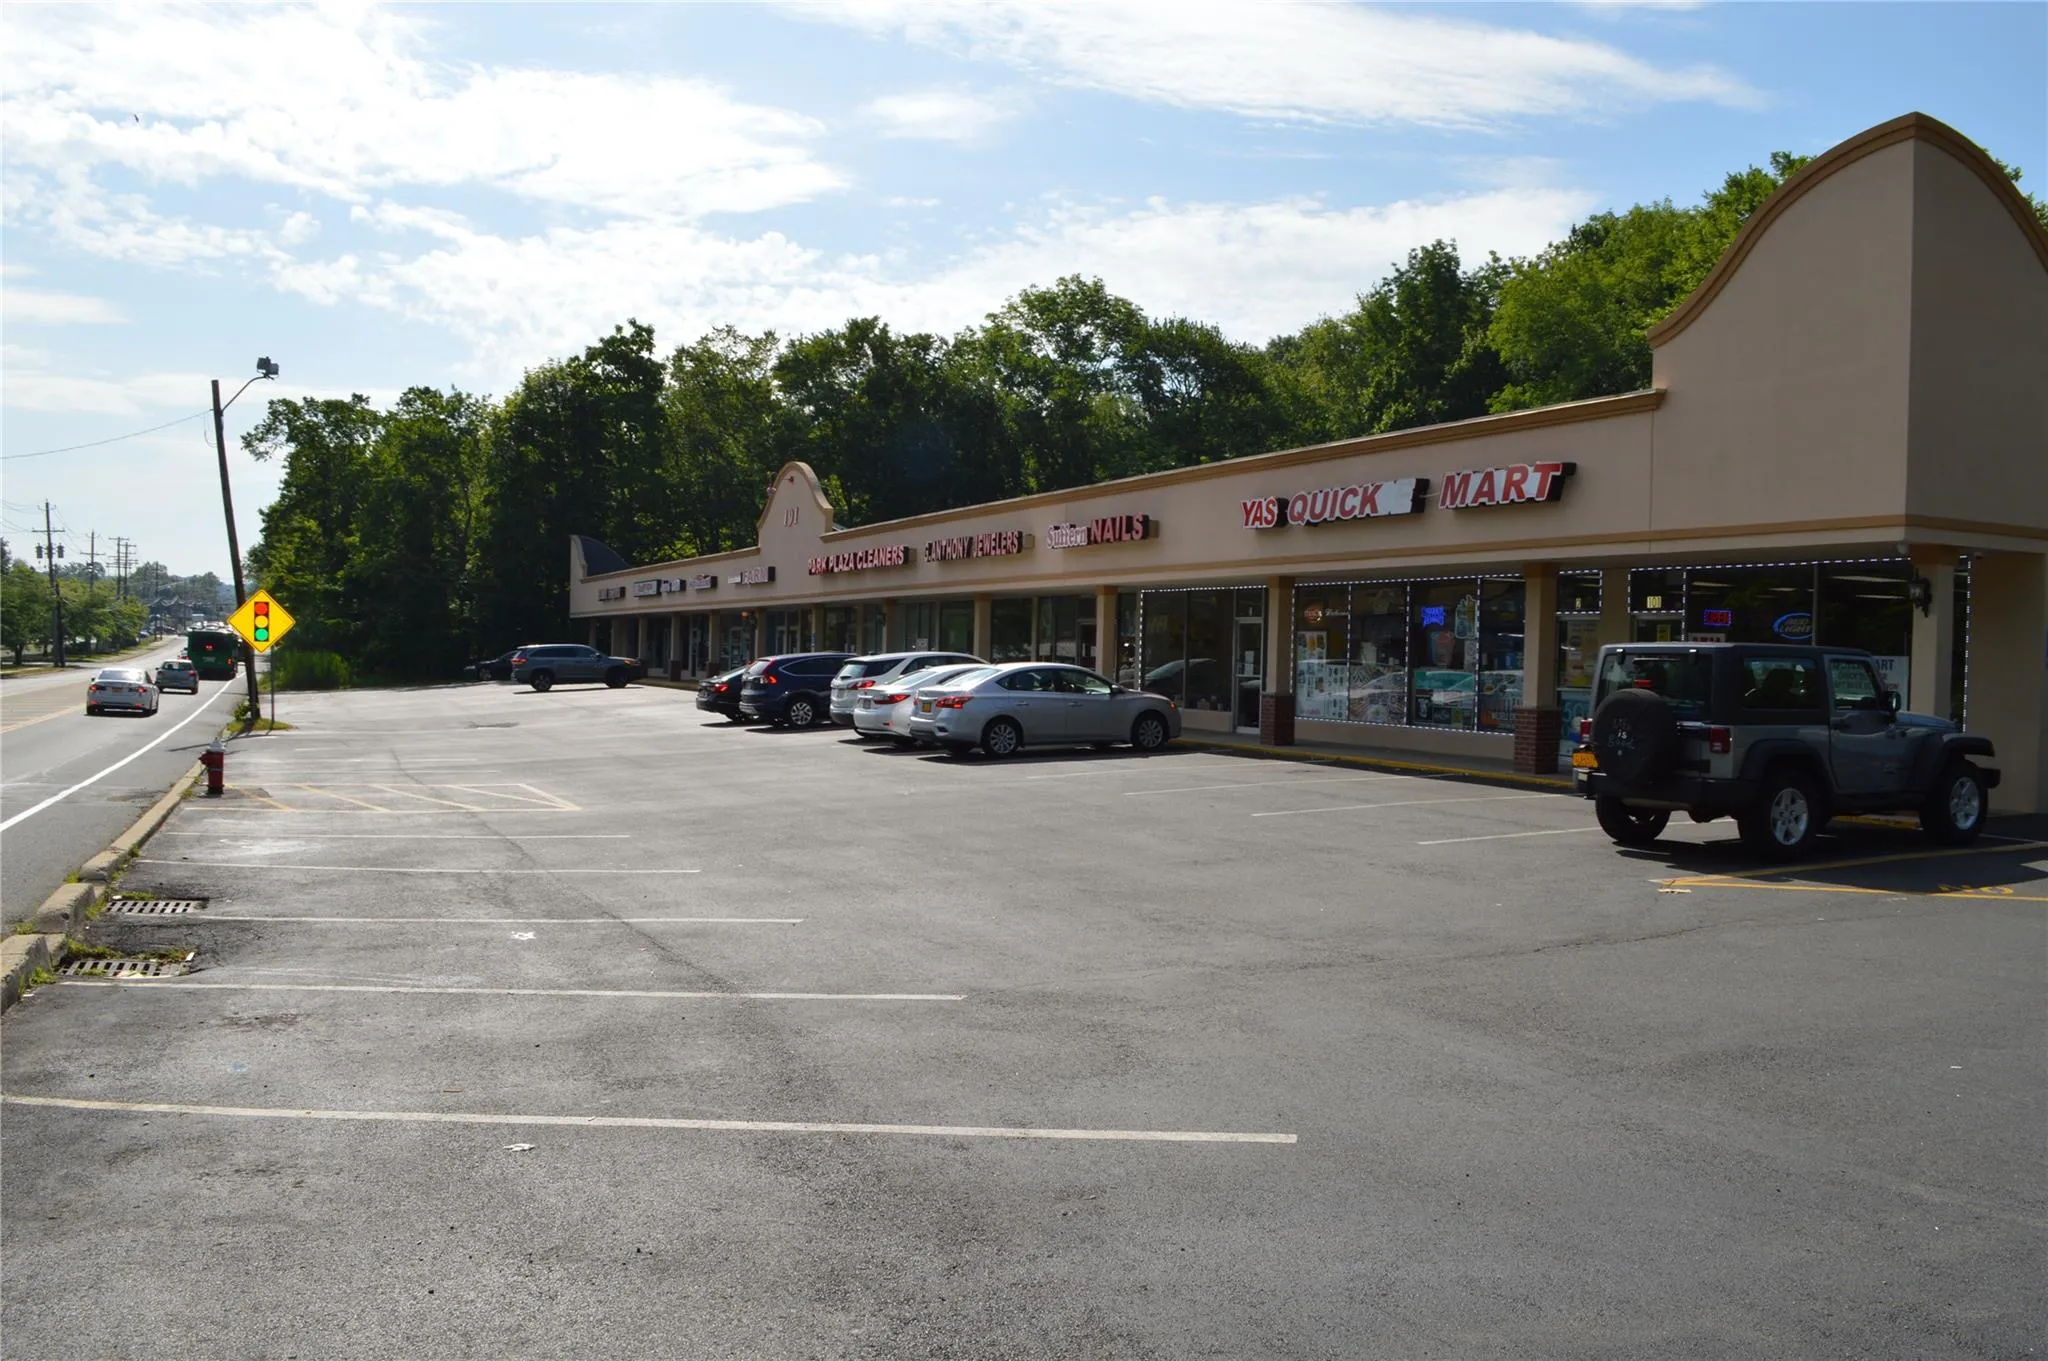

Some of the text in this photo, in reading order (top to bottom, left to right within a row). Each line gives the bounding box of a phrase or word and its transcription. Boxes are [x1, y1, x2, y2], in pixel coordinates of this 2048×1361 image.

[1240, 461, 1562, 529] YAS QUICK MART
[973, 530, 1018, 558] JEWELERS
[1047, 512, 1144, 548] Suffern NAILS
[807, 545, 904, 575] PARK PLAZA CLEANERS
